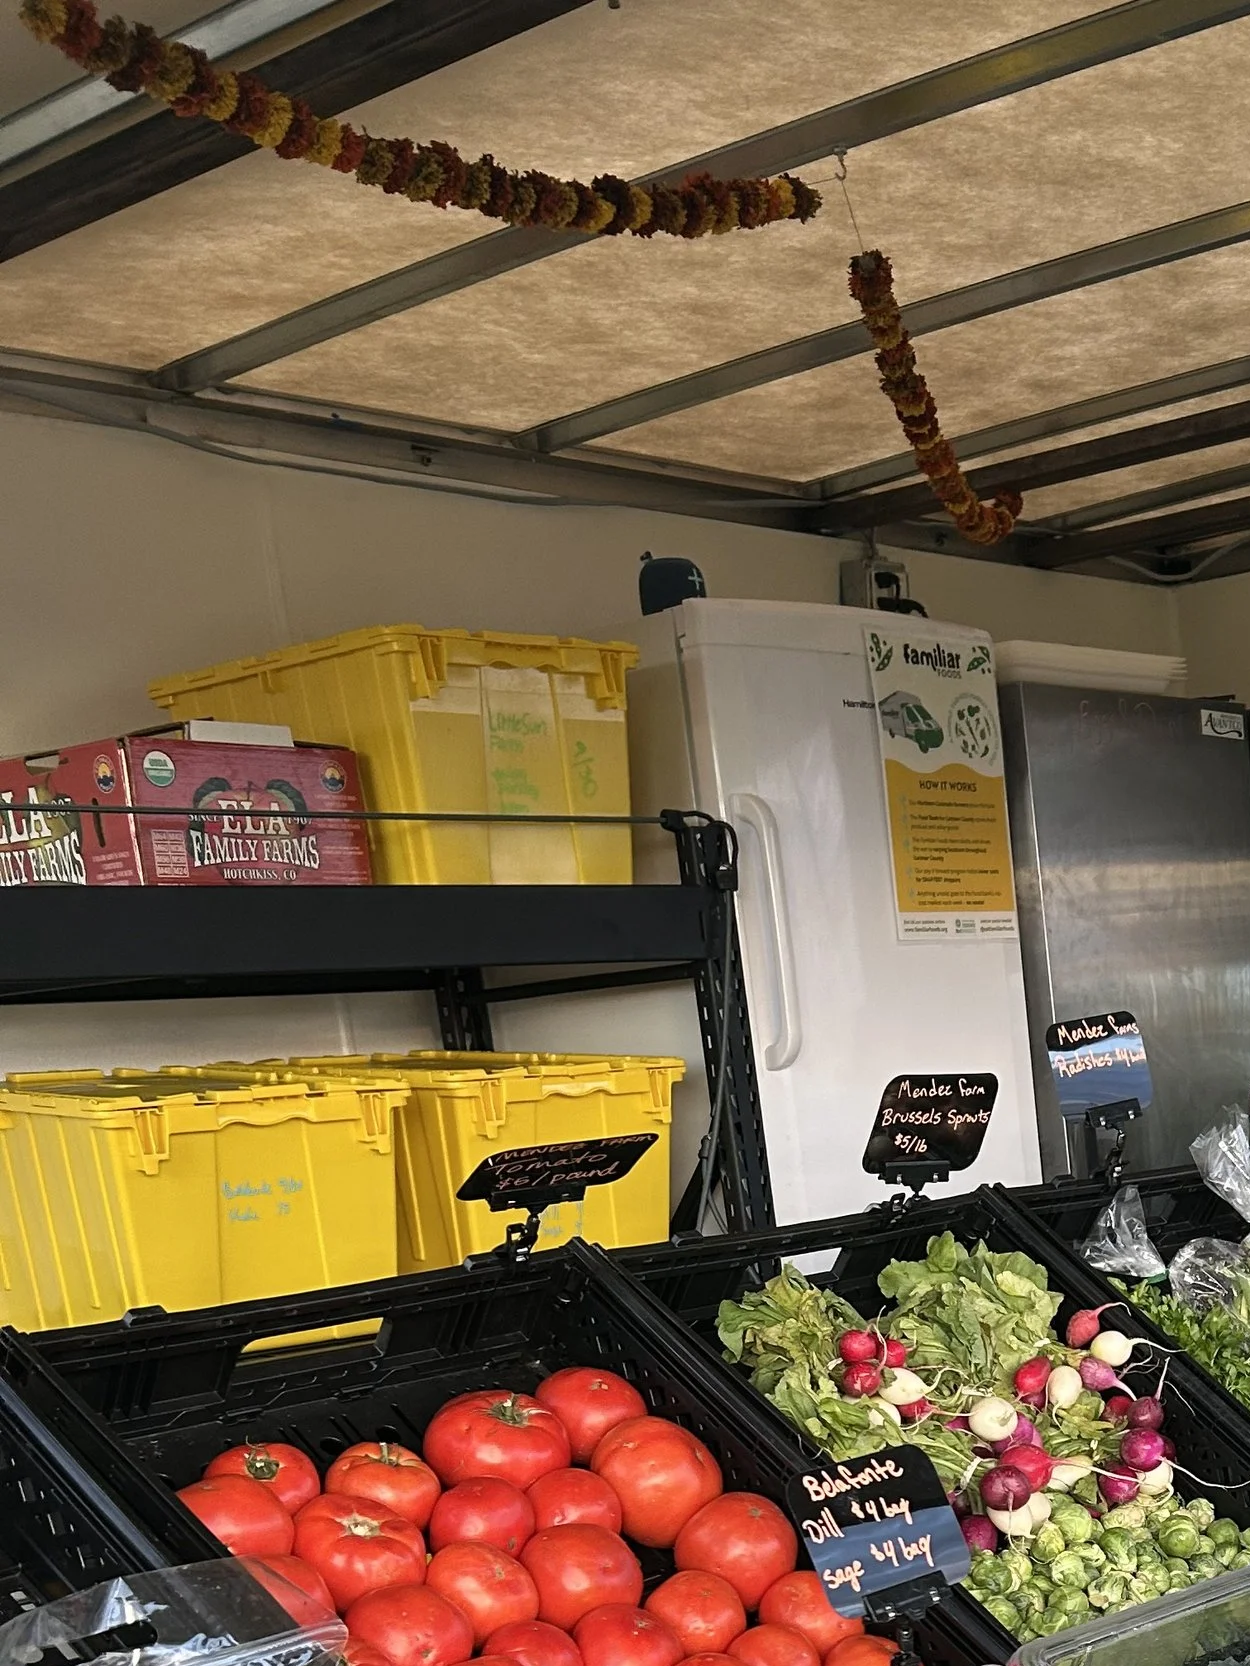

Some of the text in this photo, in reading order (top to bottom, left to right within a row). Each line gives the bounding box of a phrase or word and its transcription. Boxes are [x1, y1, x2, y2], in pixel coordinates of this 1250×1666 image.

[903, 643, 961, 672] familiar
[937, 668, 962, 679] FOODS
[919, 780, 978, 793] HOW IT WORKS
[0, 787, 52, 844] LA
[218, 799, 290, 836] ELA
[27, 829, 87, 887] FARMS
[189, 829, 258, 868] FAMILY
[262, 834, 320, 870] FARMS
[222, 868, 297, 881] HOTCHKISS, CO
[1057, 1019, 1108, 1046] Mendez
[1051, 1049, 1113, 1078] Radishes
[897, 1078, 953, 1099] Mendez
[881, 1107, 991, 1131] Brussels Sprouts
[600, 1133, 654, 1148] FARM
[802, 1458, 904, 1501] Belafonte
[802, 1506, 845, 1544] Dill
[898, 1533, 935, 1568] bag
